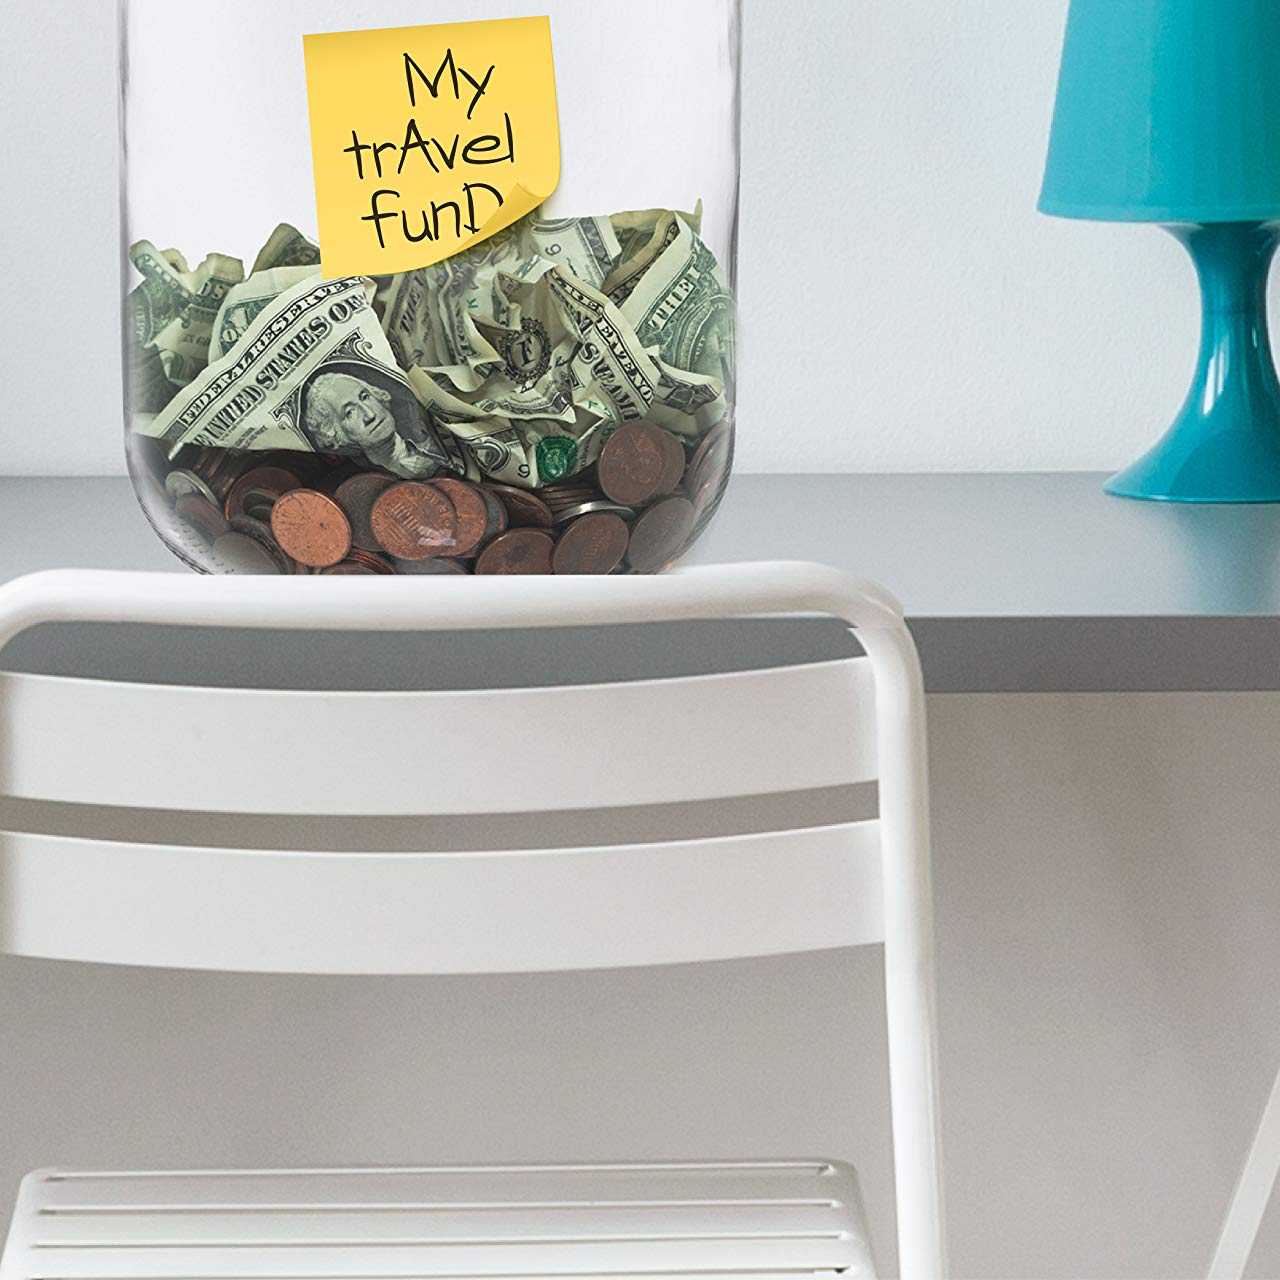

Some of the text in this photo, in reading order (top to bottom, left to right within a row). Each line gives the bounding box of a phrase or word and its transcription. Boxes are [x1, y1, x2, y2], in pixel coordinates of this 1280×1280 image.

[403, 48, 495, 120] My
[343, 112, 514, 179] trAvel
[251, 283, 345, 361] RESERVE
[255, 316, 330, 390] STATES
